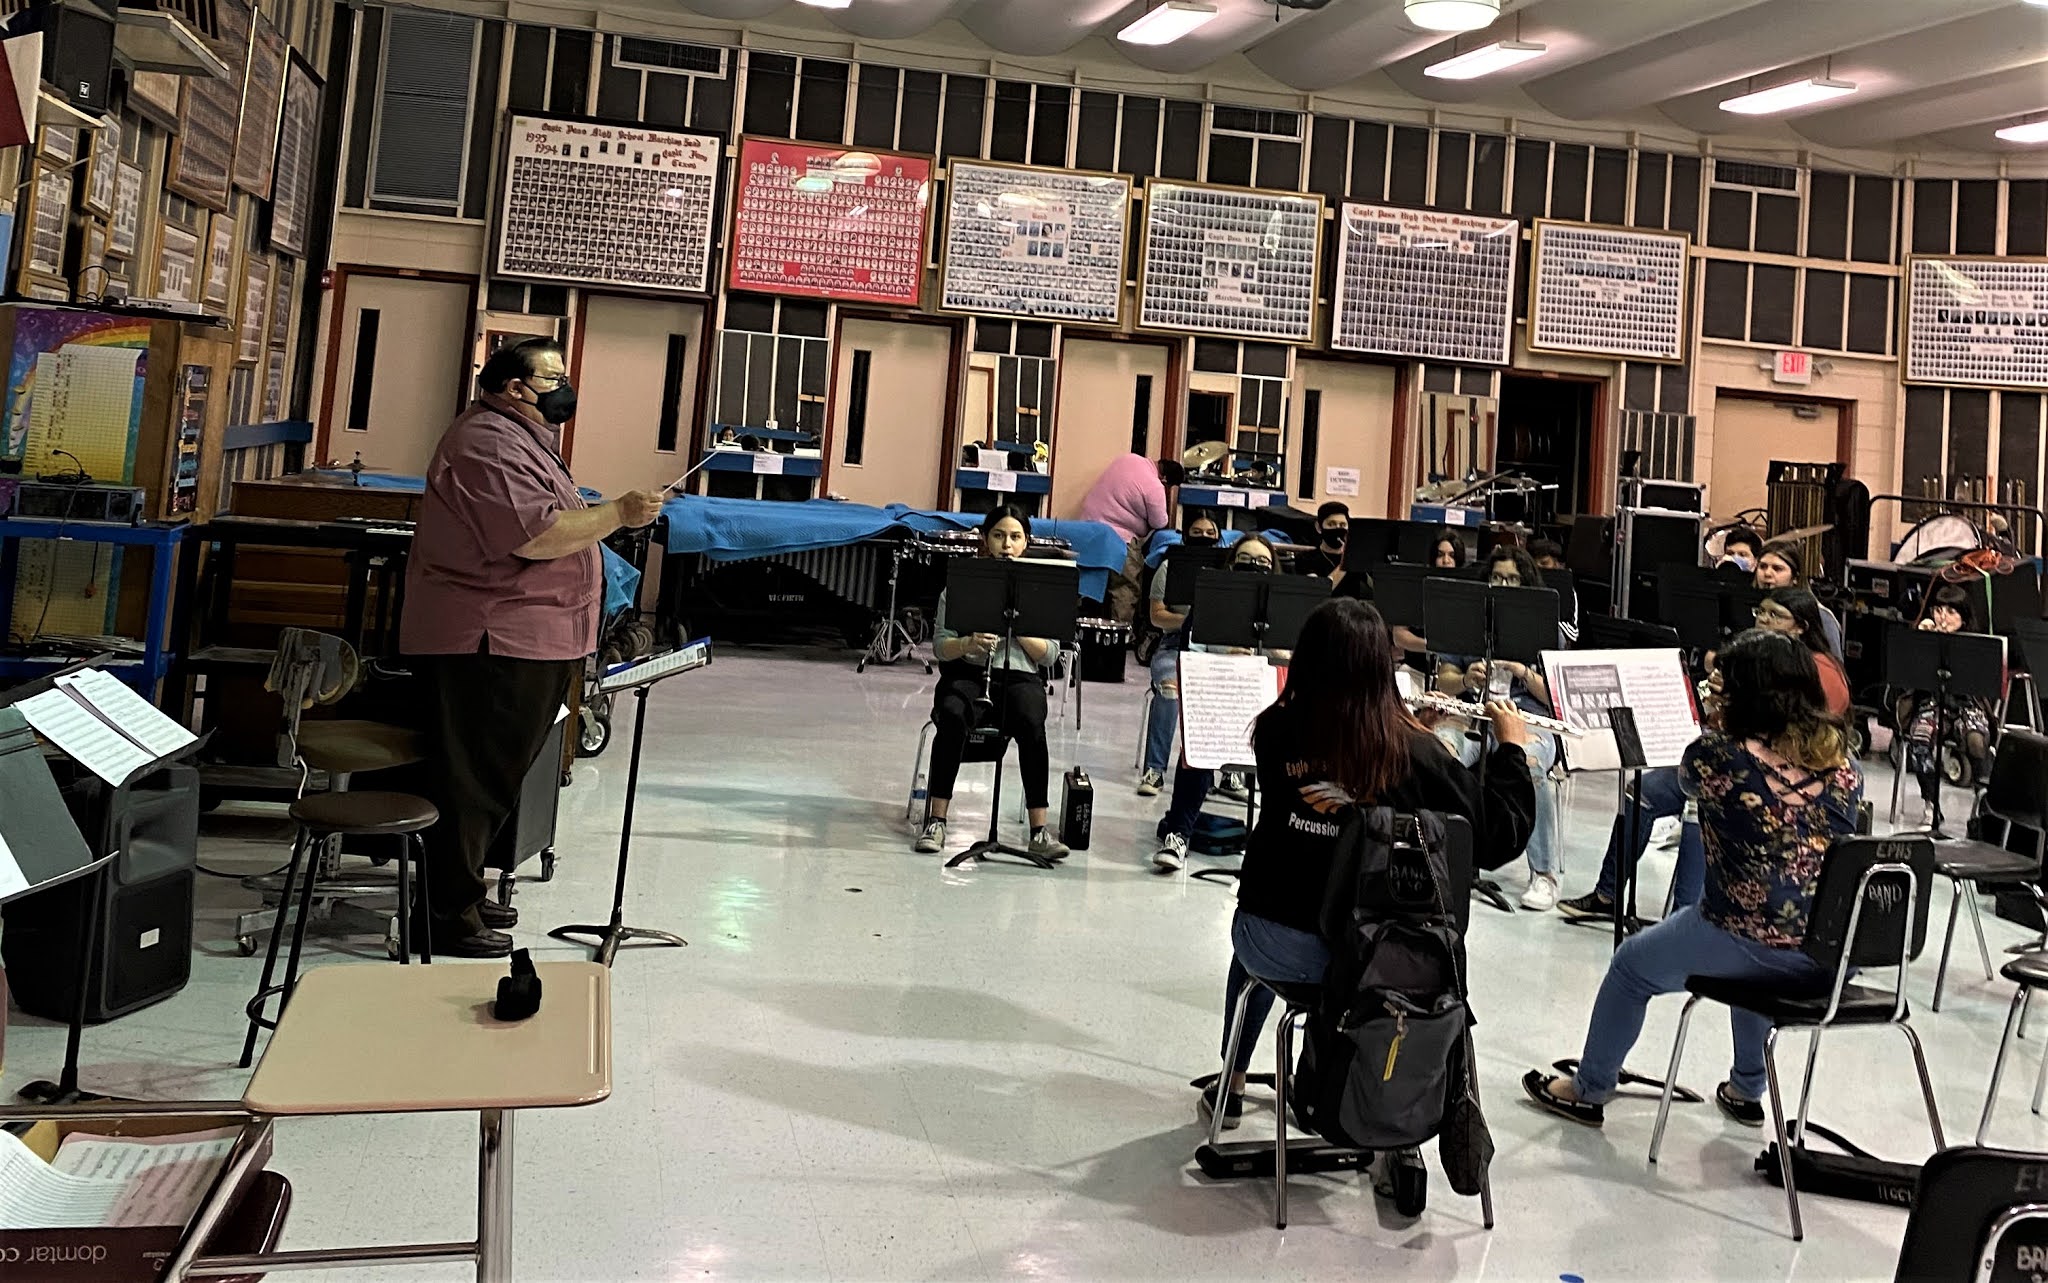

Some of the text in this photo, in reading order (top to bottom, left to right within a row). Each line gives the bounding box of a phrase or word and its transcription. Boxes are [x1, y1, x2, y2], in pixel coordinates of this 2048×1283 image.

[1352, 206, 1373, 218] Eagle
[1400, 211, 1419, 222] High
[1423, 214, 1448, 224] School
[1452, 217, 1486, 229] Marching
[1783, 352, 1805, 374] EXIT
[25, 1245, 107, 1264] domtar
